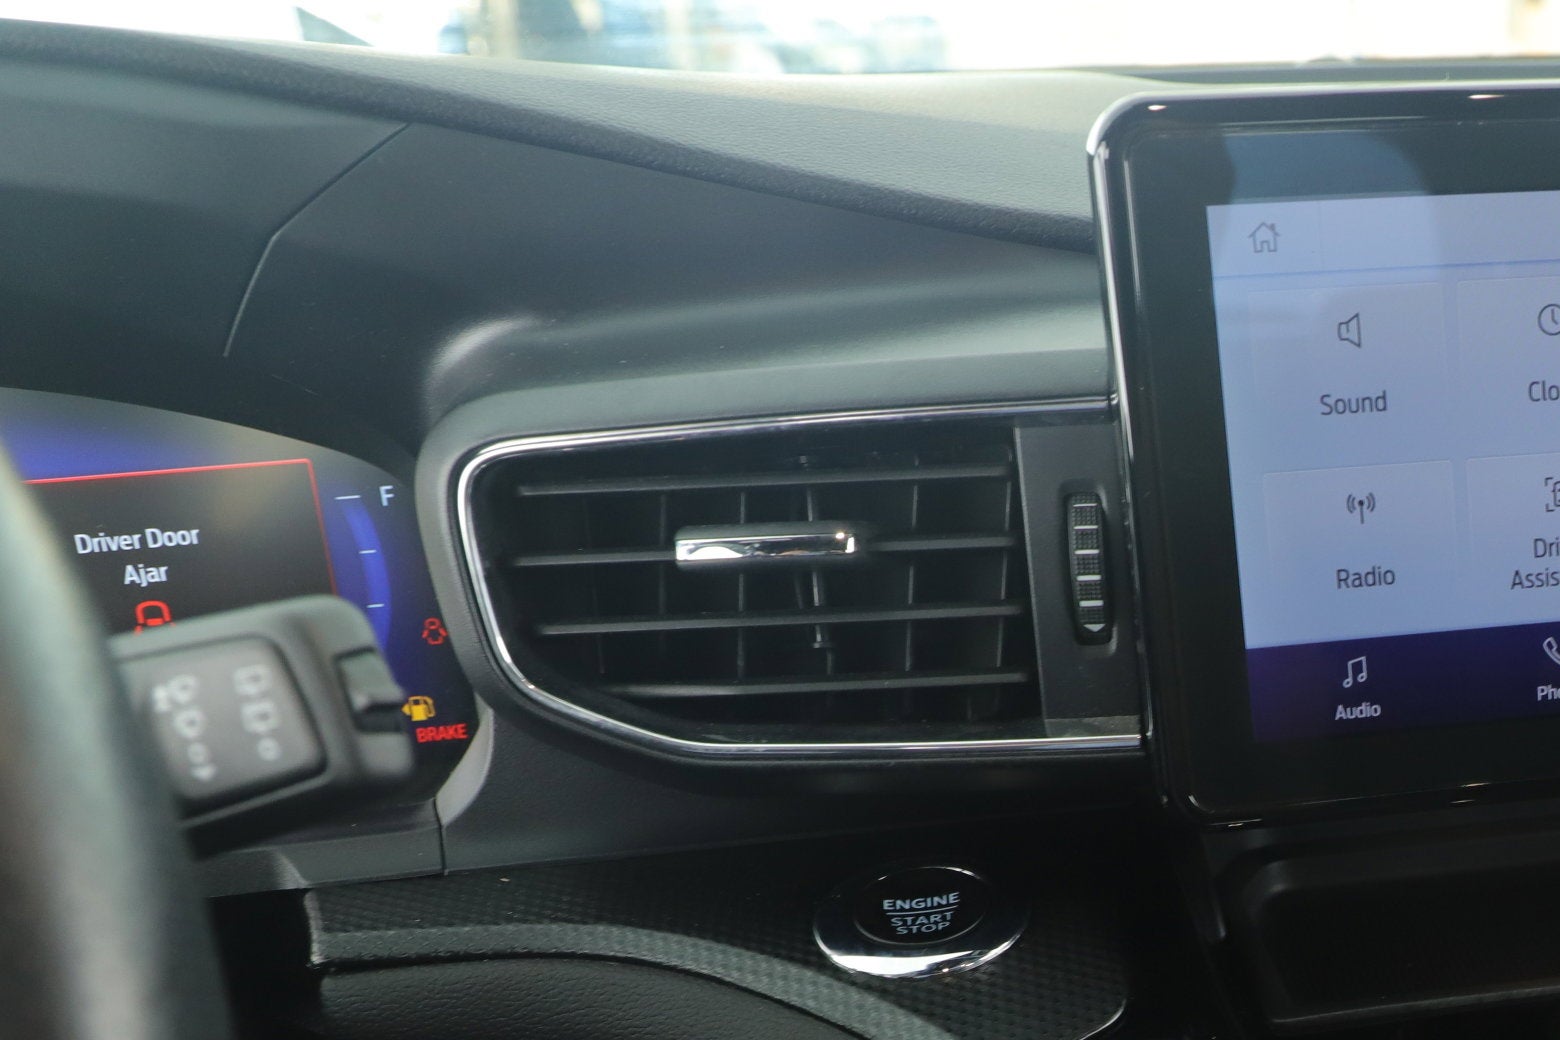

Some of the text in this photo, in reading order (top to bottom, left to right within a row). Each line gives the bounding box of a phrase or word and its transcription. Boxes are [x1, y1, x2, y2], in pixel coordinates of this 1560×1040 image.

[1319, 390, 1388, 415] Sound
[380, 485, 395, 507] F
[74, 527, 200, 555] Driver Door
[123, 563, 168, 587] Ajar
[1336, 566, 1396, 589] Radio
[1335, 702, 1381, 721] Audio
[416, 723, 468, 743] BRAKE
[882, 892, 960, 910] ENGINE
[891, 912, 954, 926] START
[896, 922, 950, 935] STOP
